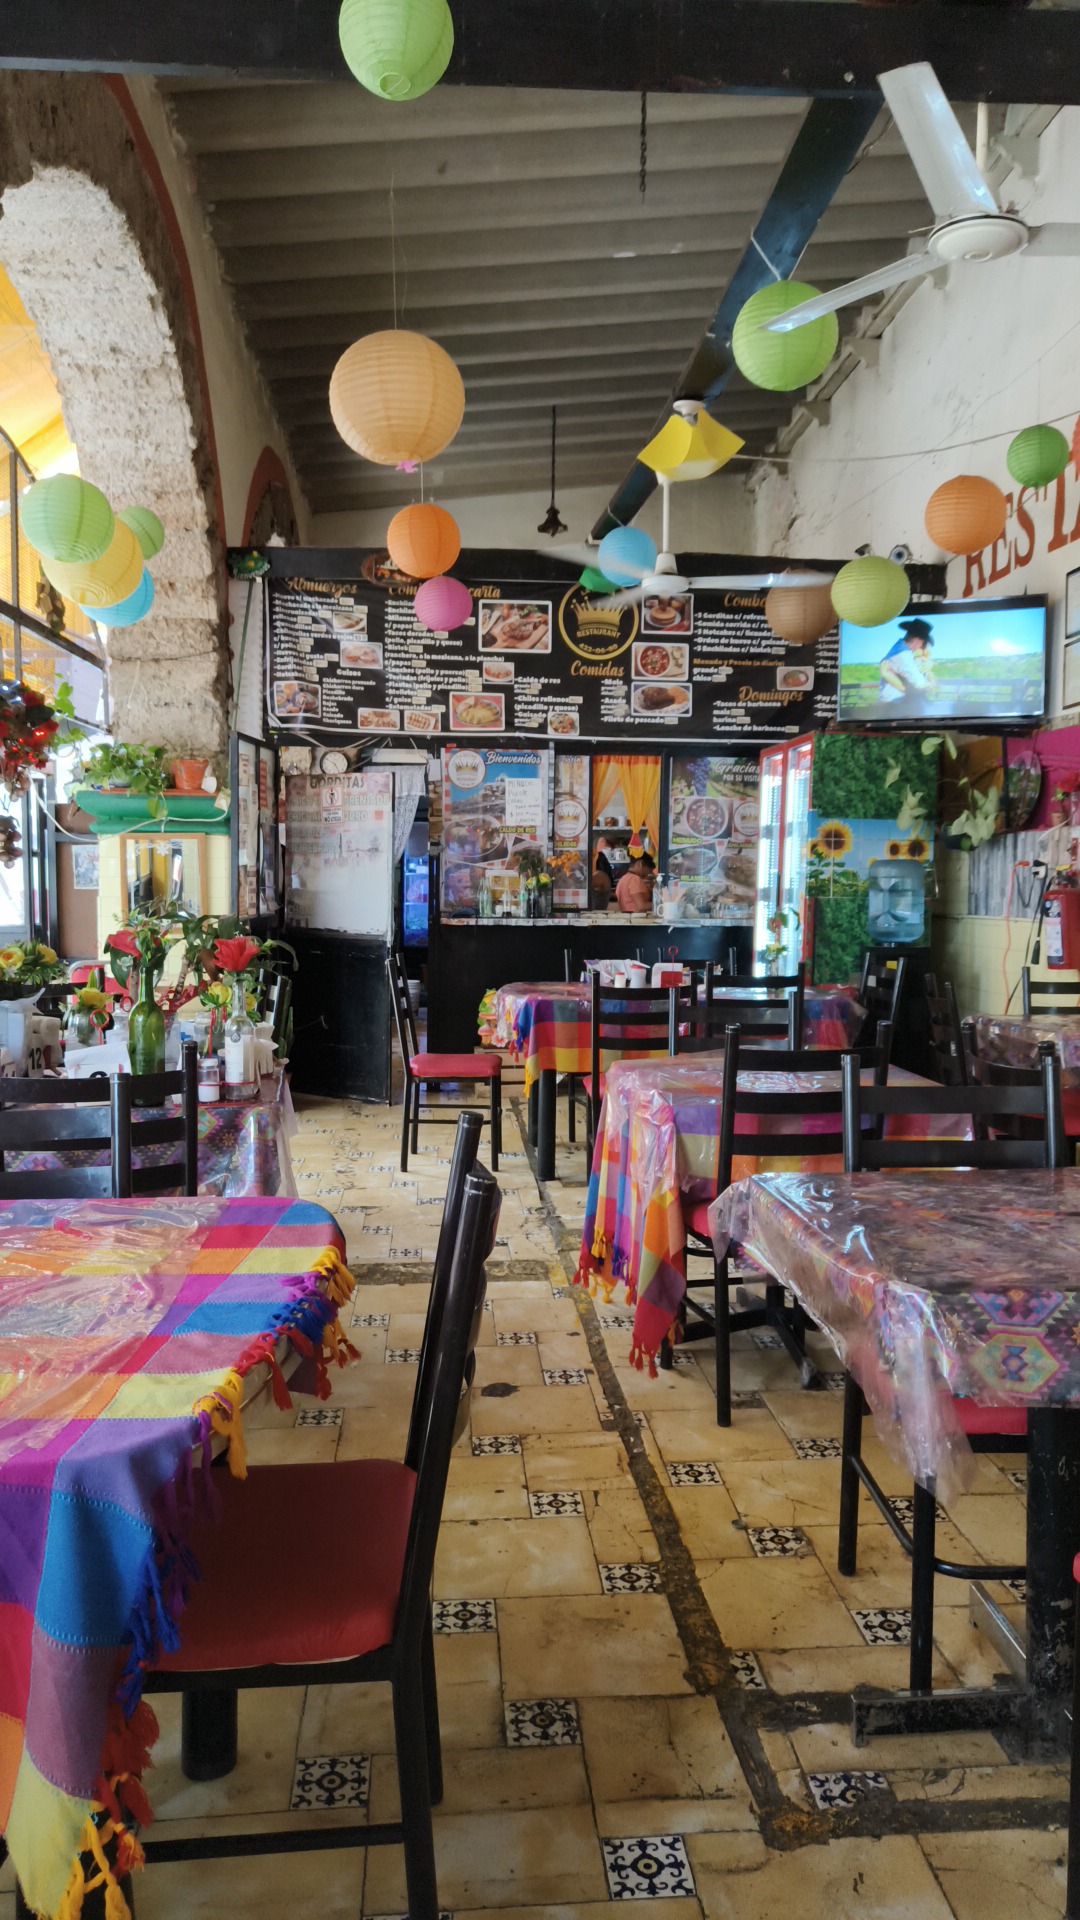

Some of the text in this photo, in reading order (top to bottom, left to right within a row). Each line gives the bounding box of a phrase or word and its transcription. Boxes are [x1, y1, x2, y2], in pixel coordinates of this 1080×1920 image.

[286, 578, 358, 598] Almuerzos
[703, 612, 734, 620] Gorditas
[407, 630, 434, 638] dorados
[576, 628, 621, 638] RESTAURANT
[406, 638, 435, 646] picadillo
[570, 660, 625, 676] Comidas
[539, 676, 548, 684] de
[738, 686, 804, 706] Domingos
[514, 702, 548, 711] (picadillo
[634, 716, 664, 724] pescado
[486, 751, 542, 764] Bienvenidos
[714, 760, 760, 776] Gracias
[345, 794, 390, 806] RENSADO
[29, 1047, 42, 1070] 12
